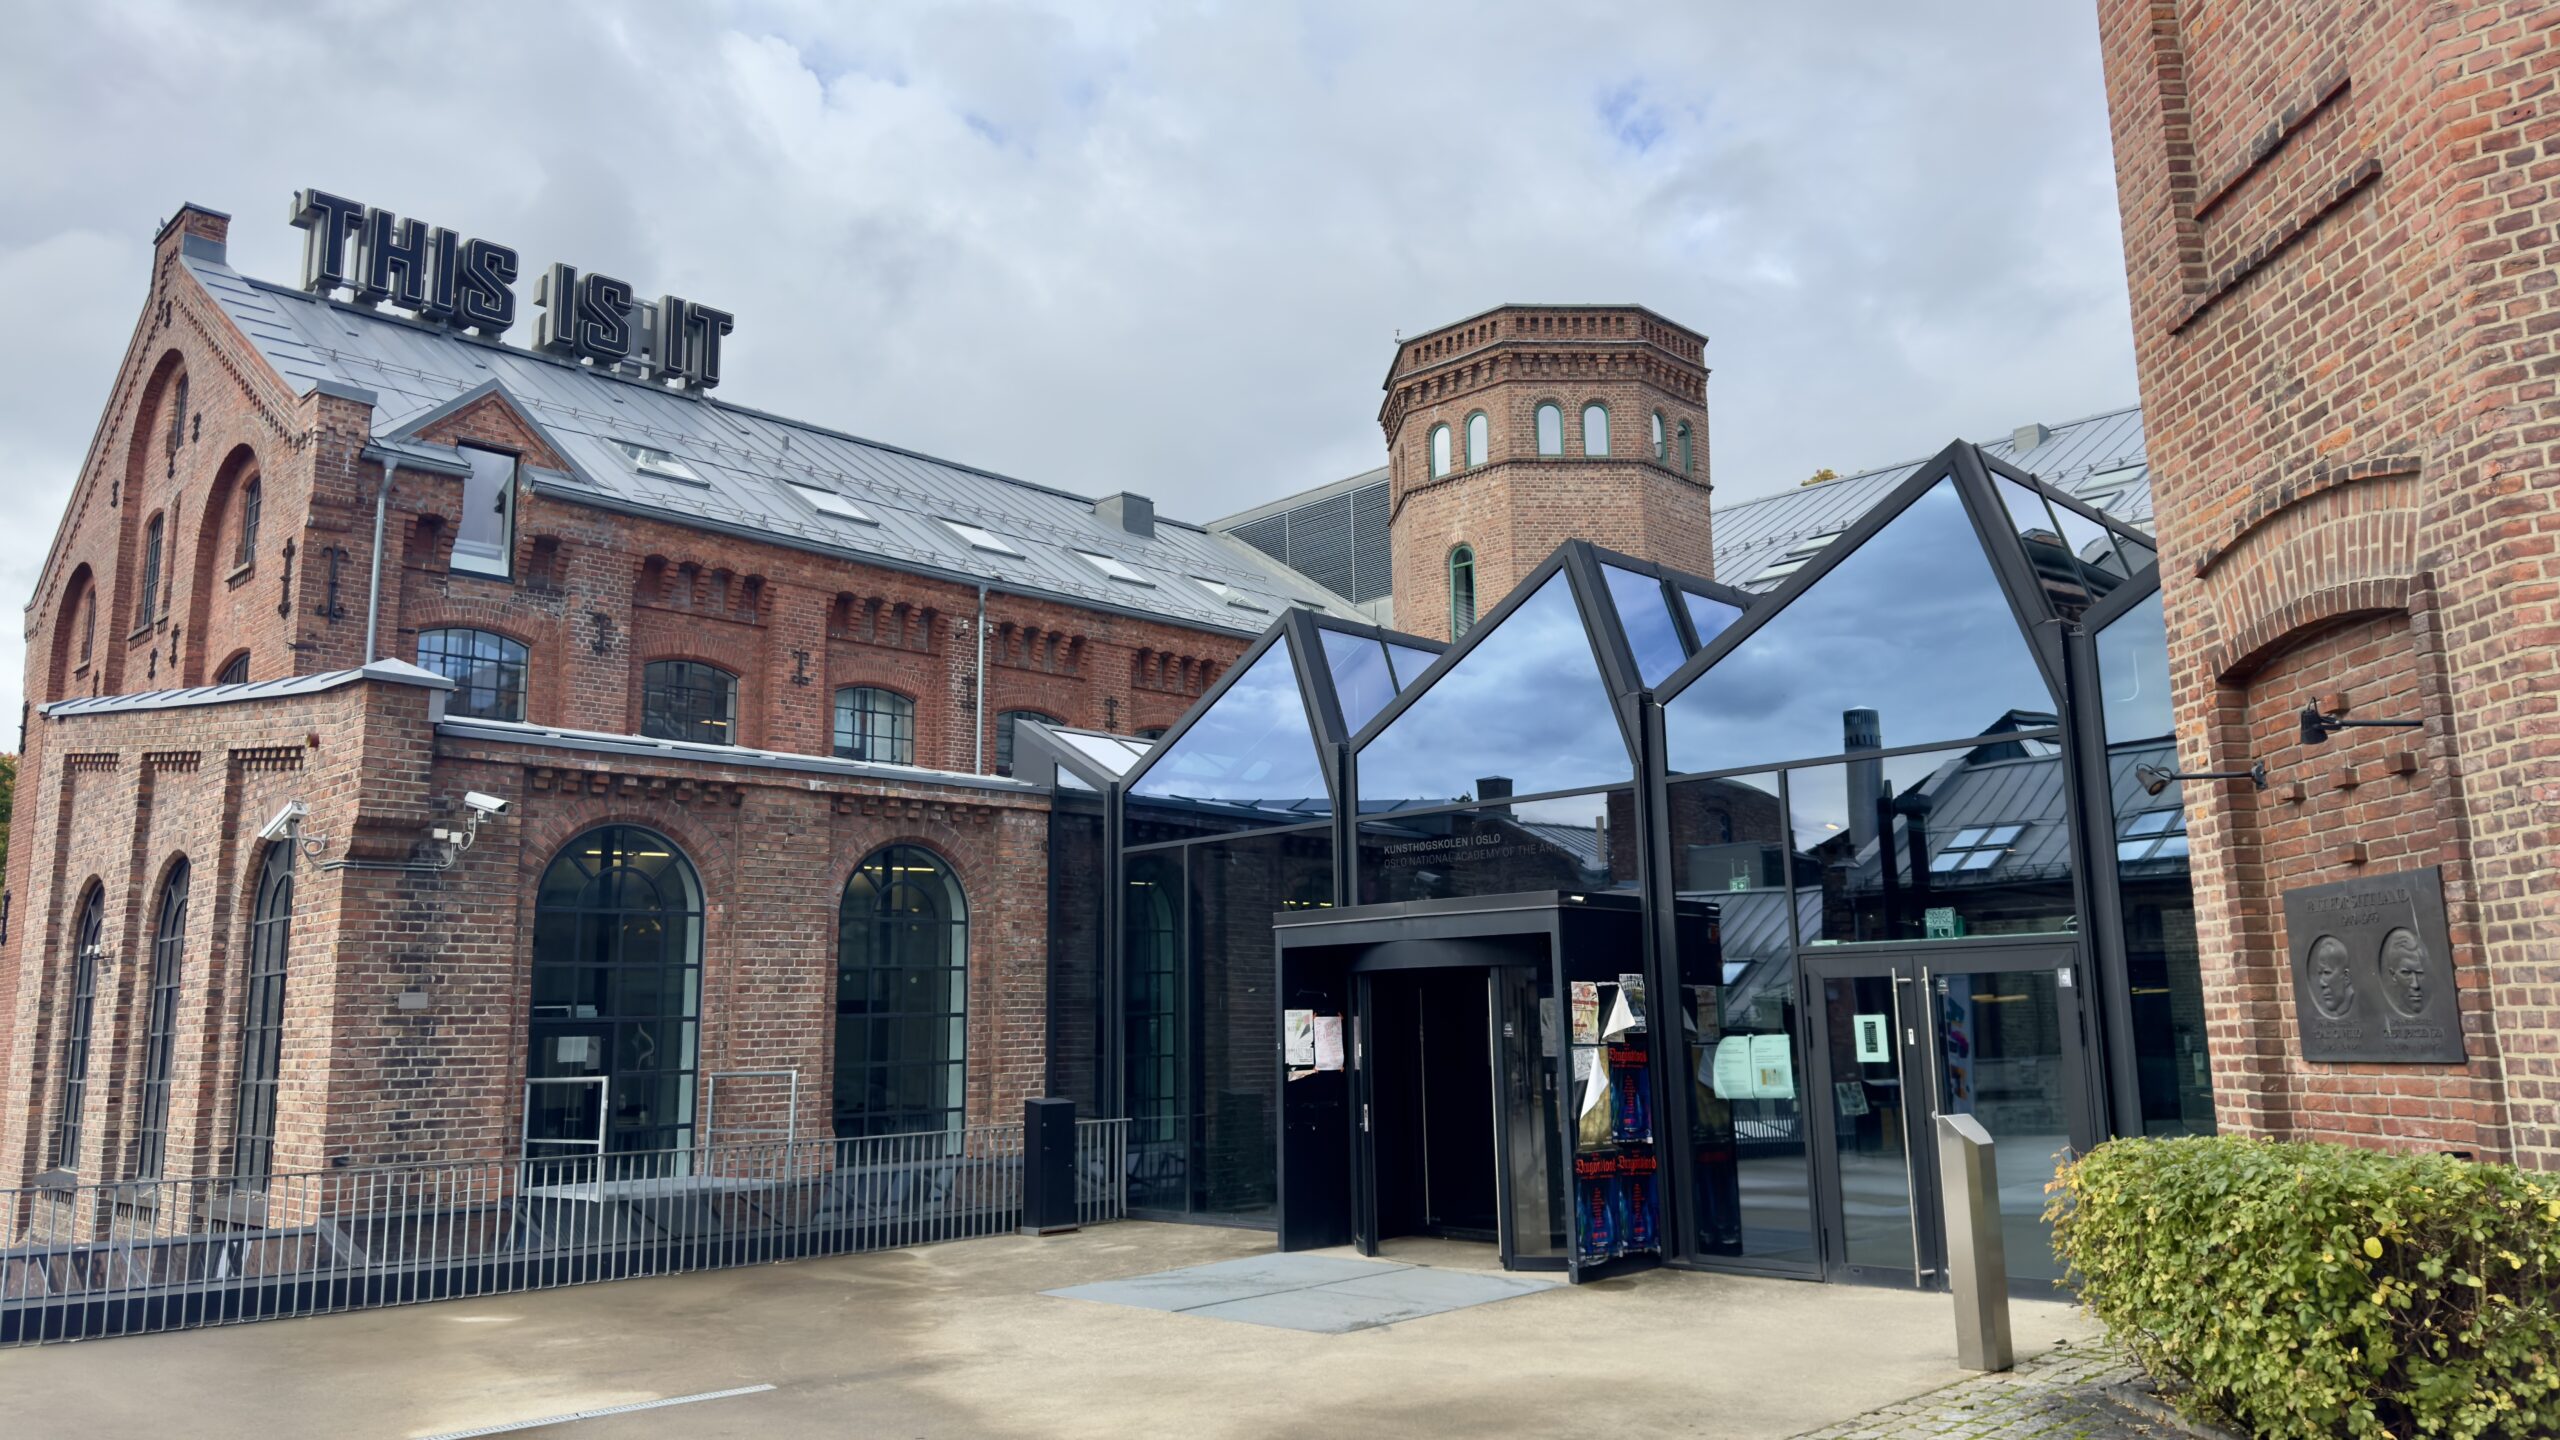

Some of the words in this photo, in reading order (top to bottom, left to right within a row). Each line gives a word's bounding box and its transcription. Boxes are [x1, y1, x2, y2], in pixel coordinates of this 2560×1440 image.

[303, 188, 519, 333] THIS
[545, 262, 634, 361] IS
[657, 295, 735, 389] IT
[1384, 836, 1468, 855] KUNSTHØGSKOLEN
[1476, 833, 1501, 845] OSLO
[1384, 857, 1407, 869] OSLO
[1409, 851, 1453, 865] NATIONAL
[1455, 847, 1499, 862] ACADEMY
[1502, 846, 1515, 857] OF
[1518, 843, 1537, 857] THE
